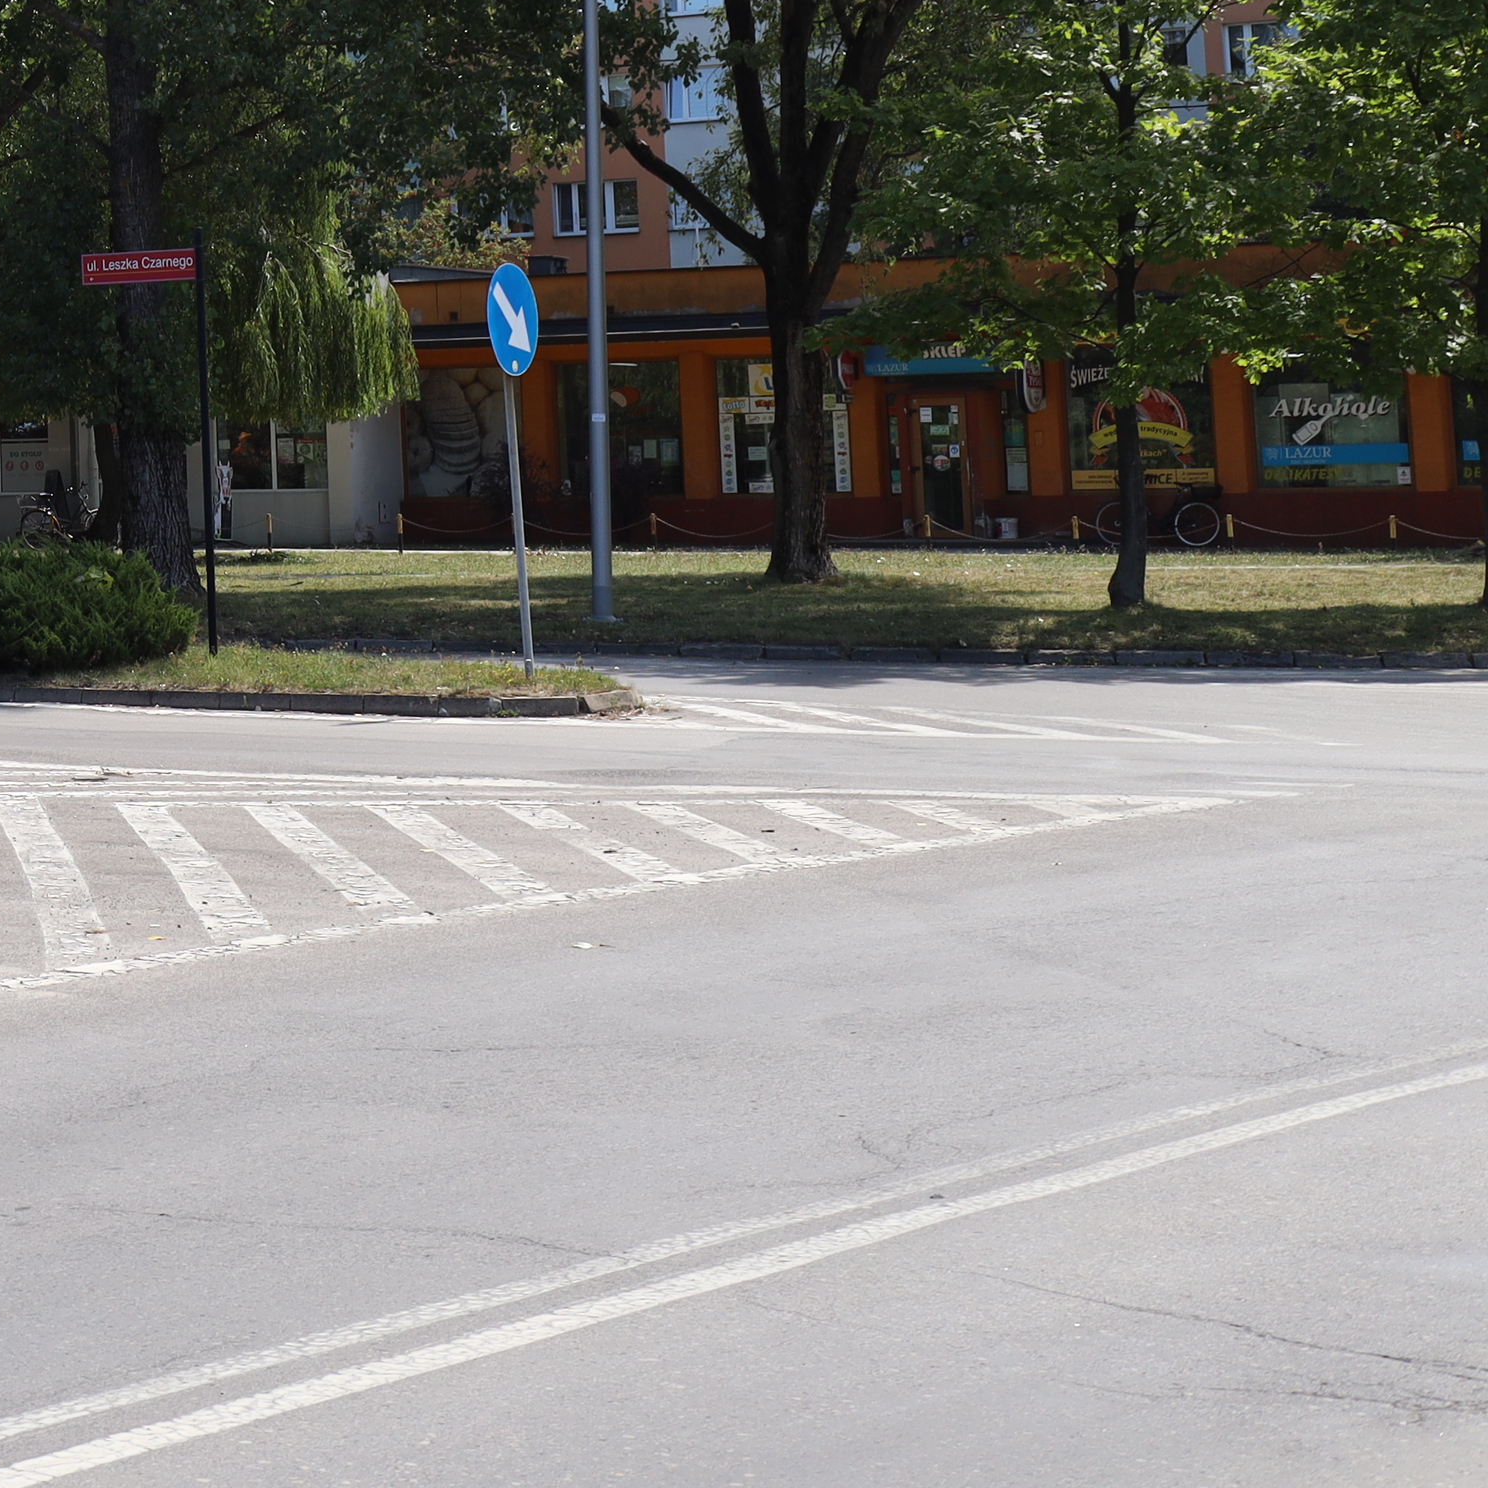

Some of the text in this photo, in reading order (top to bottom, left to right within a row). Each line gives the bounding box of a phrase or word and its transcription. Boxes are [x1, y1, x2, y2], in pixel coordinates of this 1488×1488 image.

[87, 256, 193, 272] ul. Leszka Czarnego
[877, 363, 909, 372] LAZUR
[723, 399, 747, 412] Lotto
[1268, 395, 1391, 419] Alkohole
[1140, 425, 1178, 437] tradycyjna
[1284, 446, 1332, 459] LAZUR
